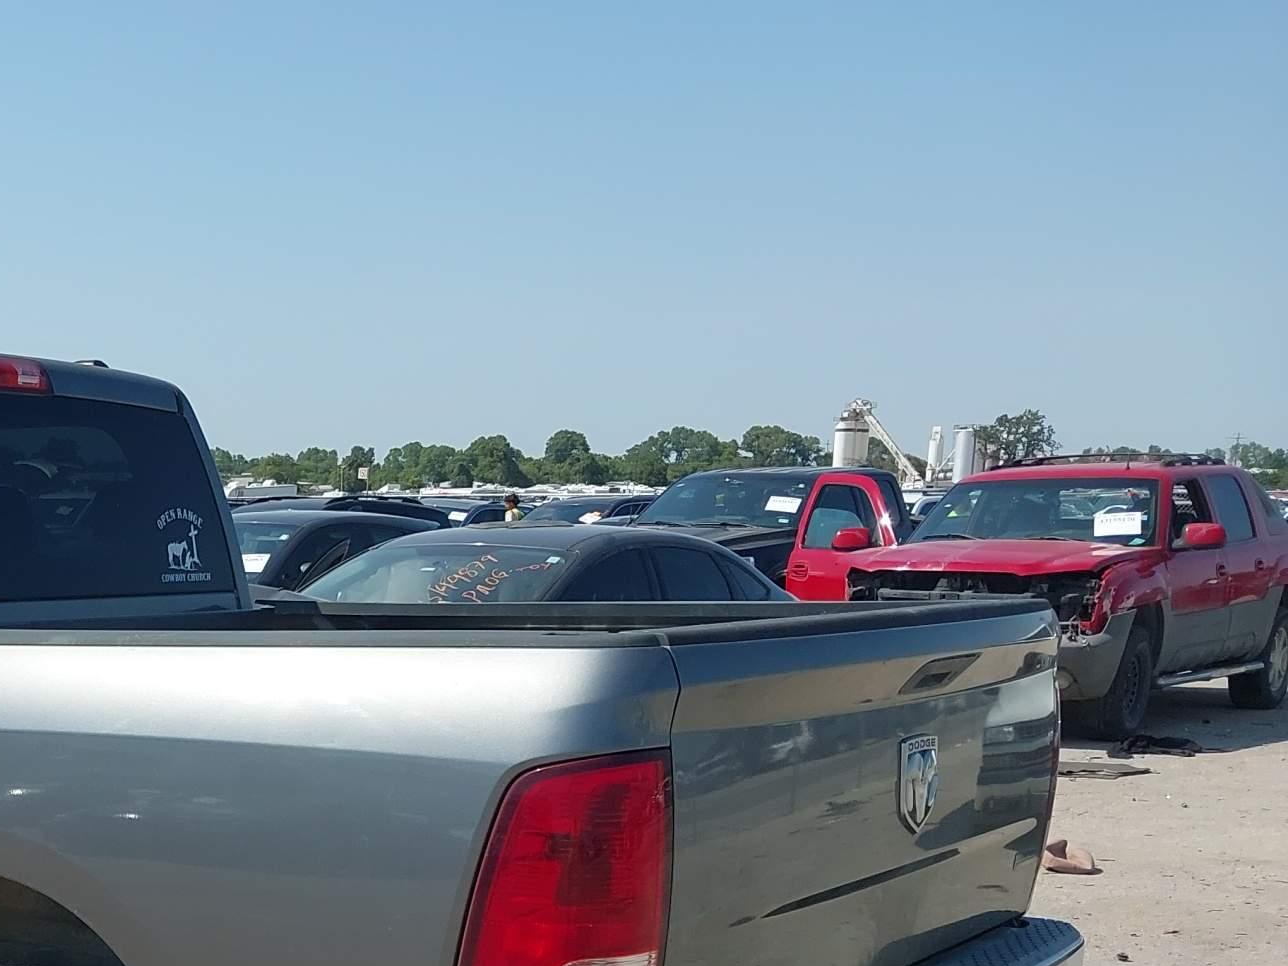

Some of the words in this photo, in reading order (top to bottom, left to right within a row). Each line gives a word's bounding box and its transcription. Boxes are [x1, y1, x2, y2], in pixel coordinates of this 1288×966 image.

[157, 509, 176, 530] OPEN
[176, 507, 203, 529] RANGE
[161, 573, 186, 583] COWBOY
[186, 572, 211, 582] CHURCH
[908, 738, 936, 751] DODGE
